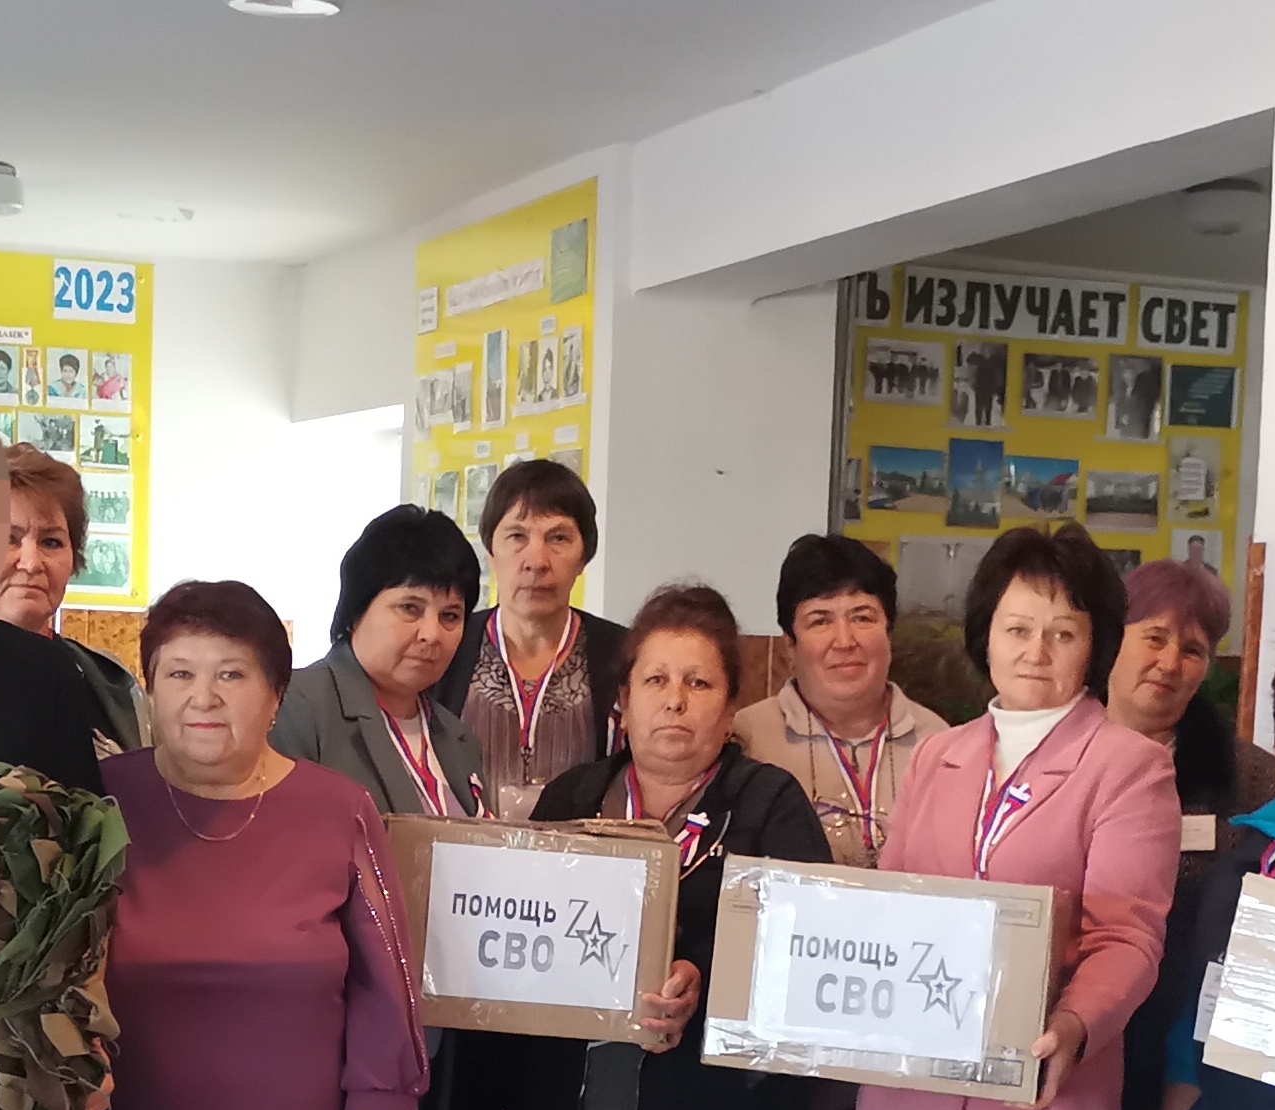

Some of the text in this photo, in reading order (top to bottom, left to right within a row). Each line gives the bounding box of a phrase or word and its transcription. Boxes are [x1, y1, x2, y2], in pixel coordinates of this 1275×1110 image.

[53, 265, 135, 314] 2023
[905, 276, 1126, 338] ИЗЛУЧАЕТ
[1141, 296, 1236, 348] СВЕТ
[451, 892, 557, 927] ПОМОЩЬ
[477, 930, 555, 973] СВО
[789, 933, 898, 970] ПОМОЩЬ
[815, 973, 895, 1018] СВО
